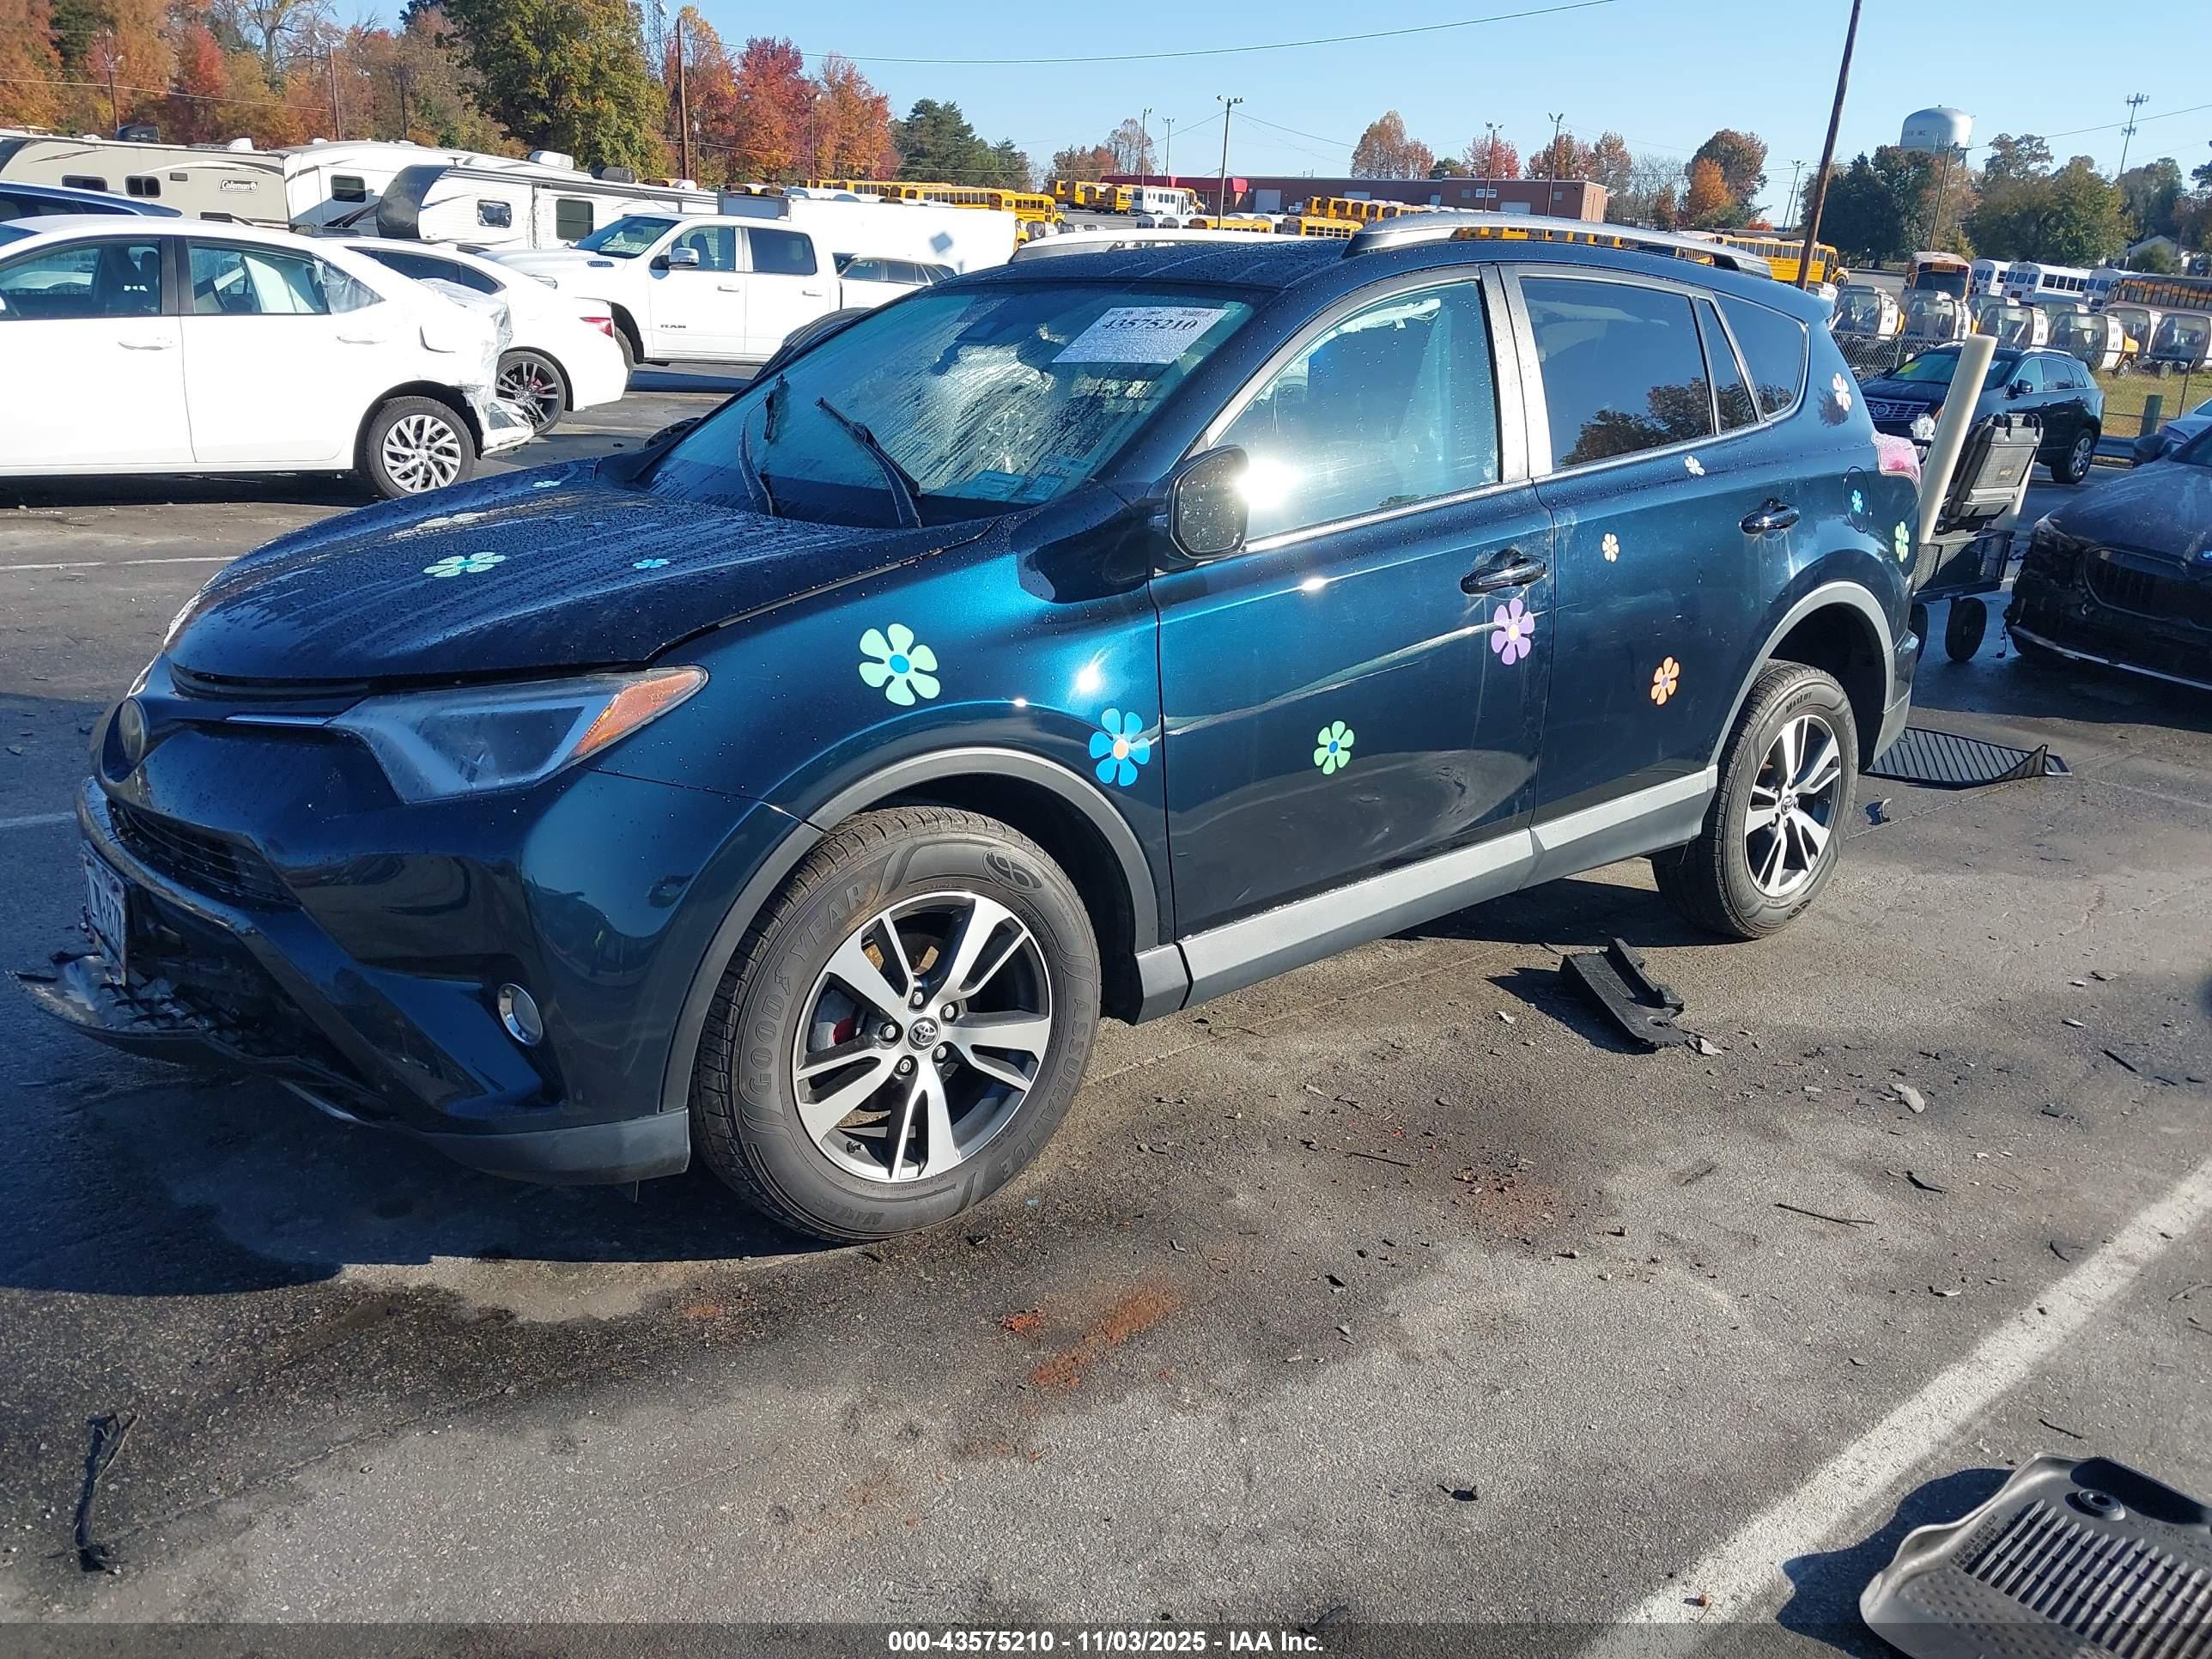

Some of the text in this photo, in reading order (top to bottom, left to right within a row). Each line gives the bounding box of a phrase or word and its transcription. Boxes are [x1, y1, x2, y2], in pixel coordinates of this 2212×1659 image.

[222, 180, 250, 191] Coleman
[1102, 318, 1199, 331] 43575210
[999, 997, 1091, 1181] ASSURANCE
